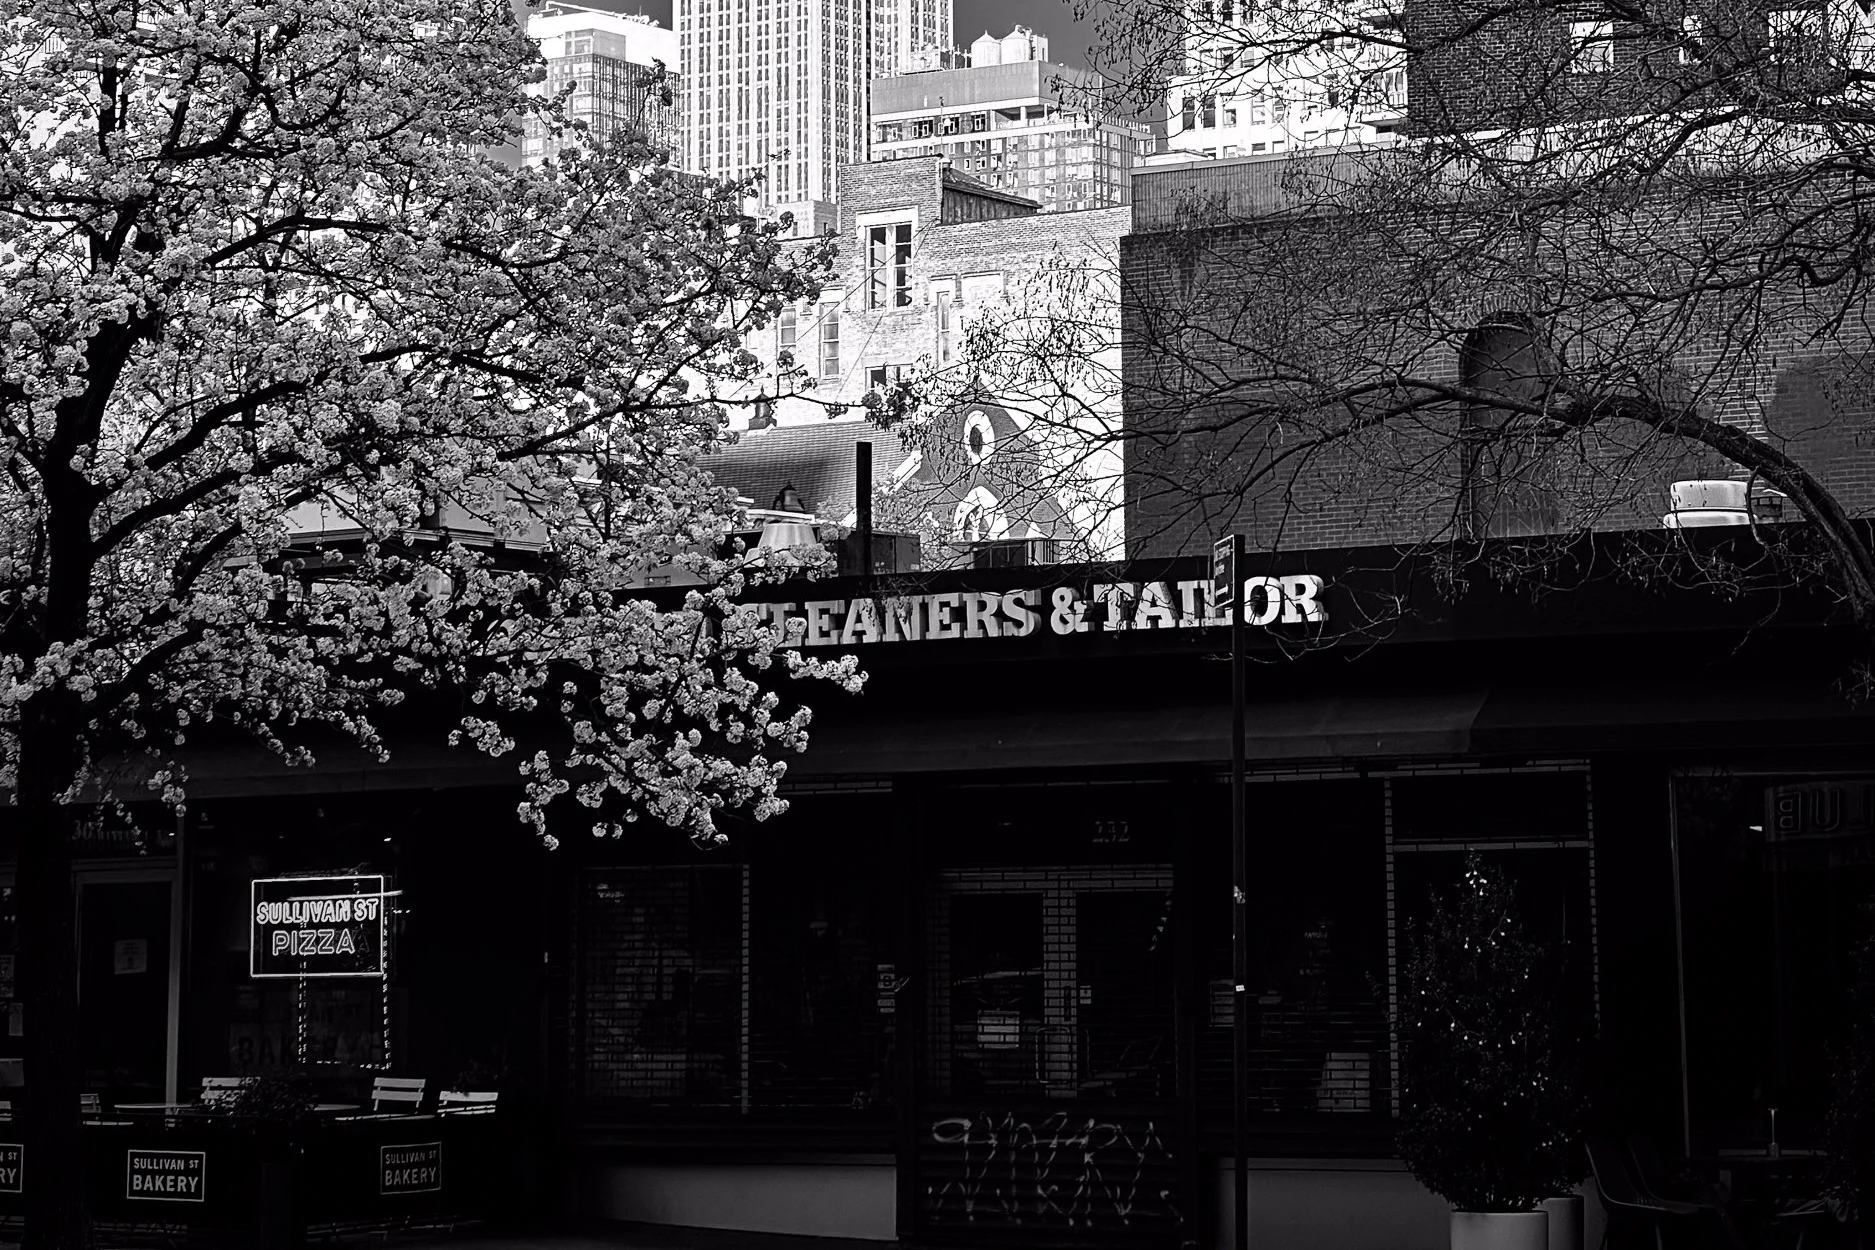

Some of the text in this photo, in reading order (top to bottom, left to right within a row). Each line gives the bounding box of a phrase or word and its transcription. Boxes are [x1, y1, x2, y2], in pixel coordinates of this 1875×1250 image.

[1050, 586, 1096, 635] &
[1093, 574, 1328, 632] TAILOR
[256, 898, 380, 925] SULLIVAN ST
[271, 927, 356, 957] PIZZA
[133, 1157, 200, 1171] SULLIVAN ST
[385, 1150, 437, 1165] SULLIVAN ST
[132, 1173, 199, 1193] BAKERY
[384, 1166, 437, 1186] BAKERY
